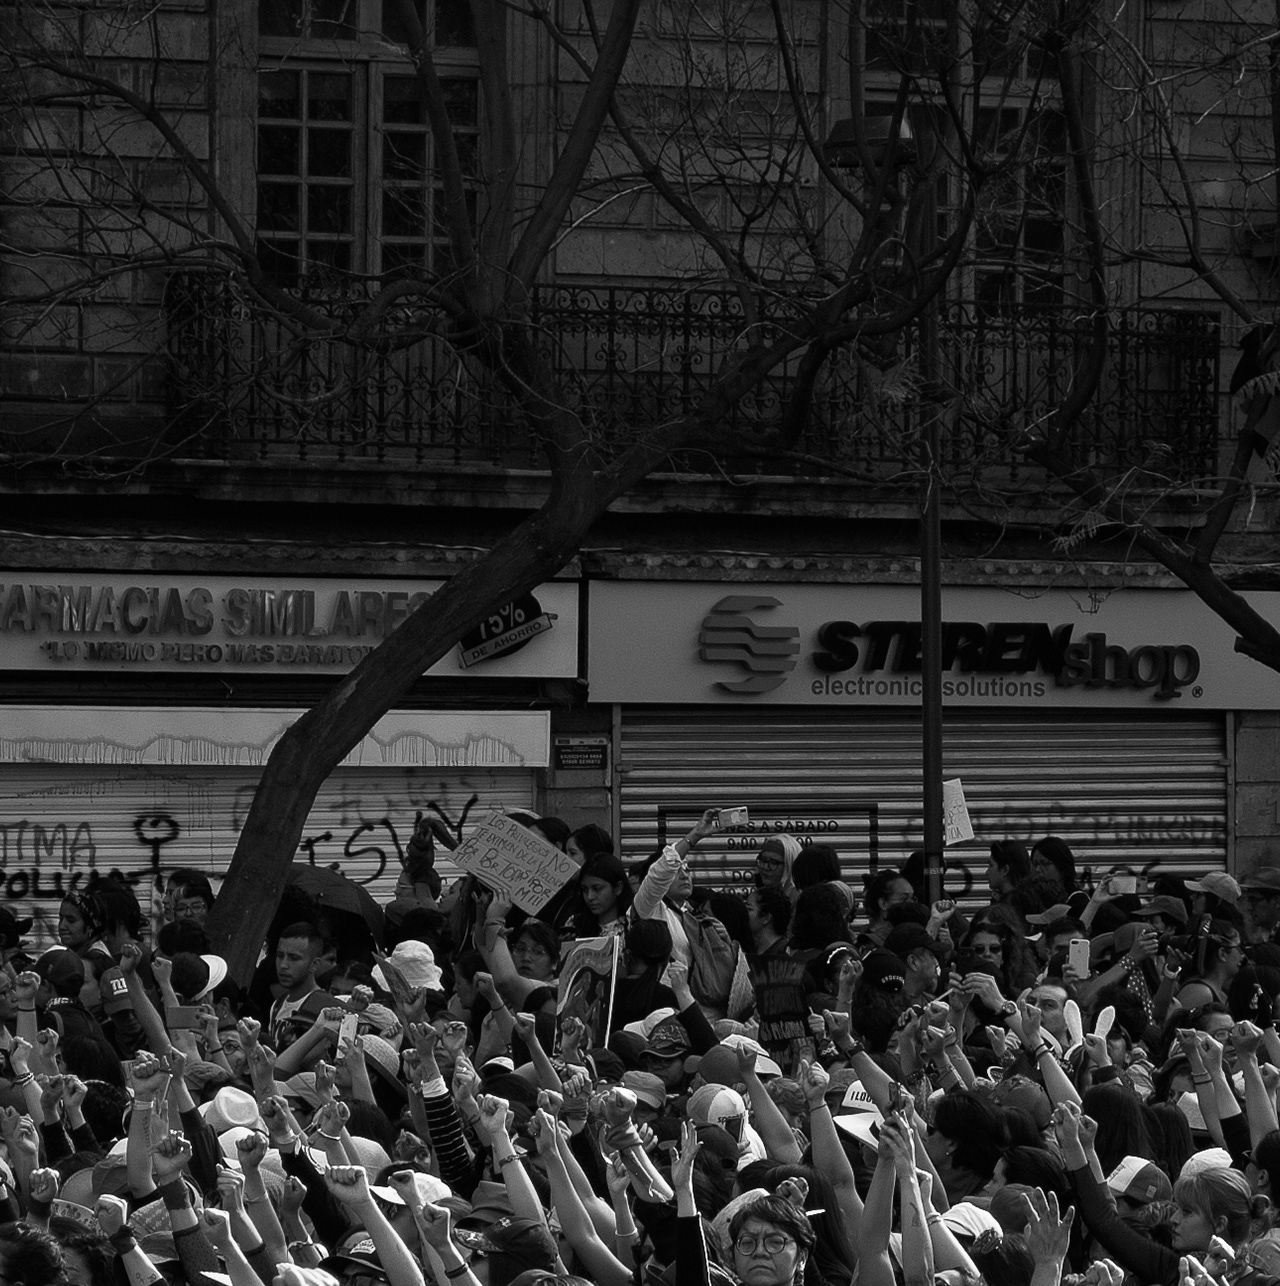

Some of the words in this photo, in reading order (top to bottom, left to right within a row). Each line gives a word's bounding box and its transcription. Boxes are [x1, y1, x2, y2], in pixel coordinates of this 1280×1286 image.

[471, 646, 488, 661] DE
[494, 621, 542, 650] AHORRO
[161, 642, 222, 663] PERO
[812, 675, 922, 697] electronic
[943, 677, 1045, 697] solutions
[761, 820, 770, 832] A
[461, 837, 479, 856] POR
[476, 828, 487, 839] TE
[515, 849, 529, 863] DE
[526, 855, 537, 865] LA
[487, 814, 507, 831] LOS
[548, 853, 570, 873] NO
[727, 837, 757, 850] 9:00
[480, 848, 499, 871] POR
